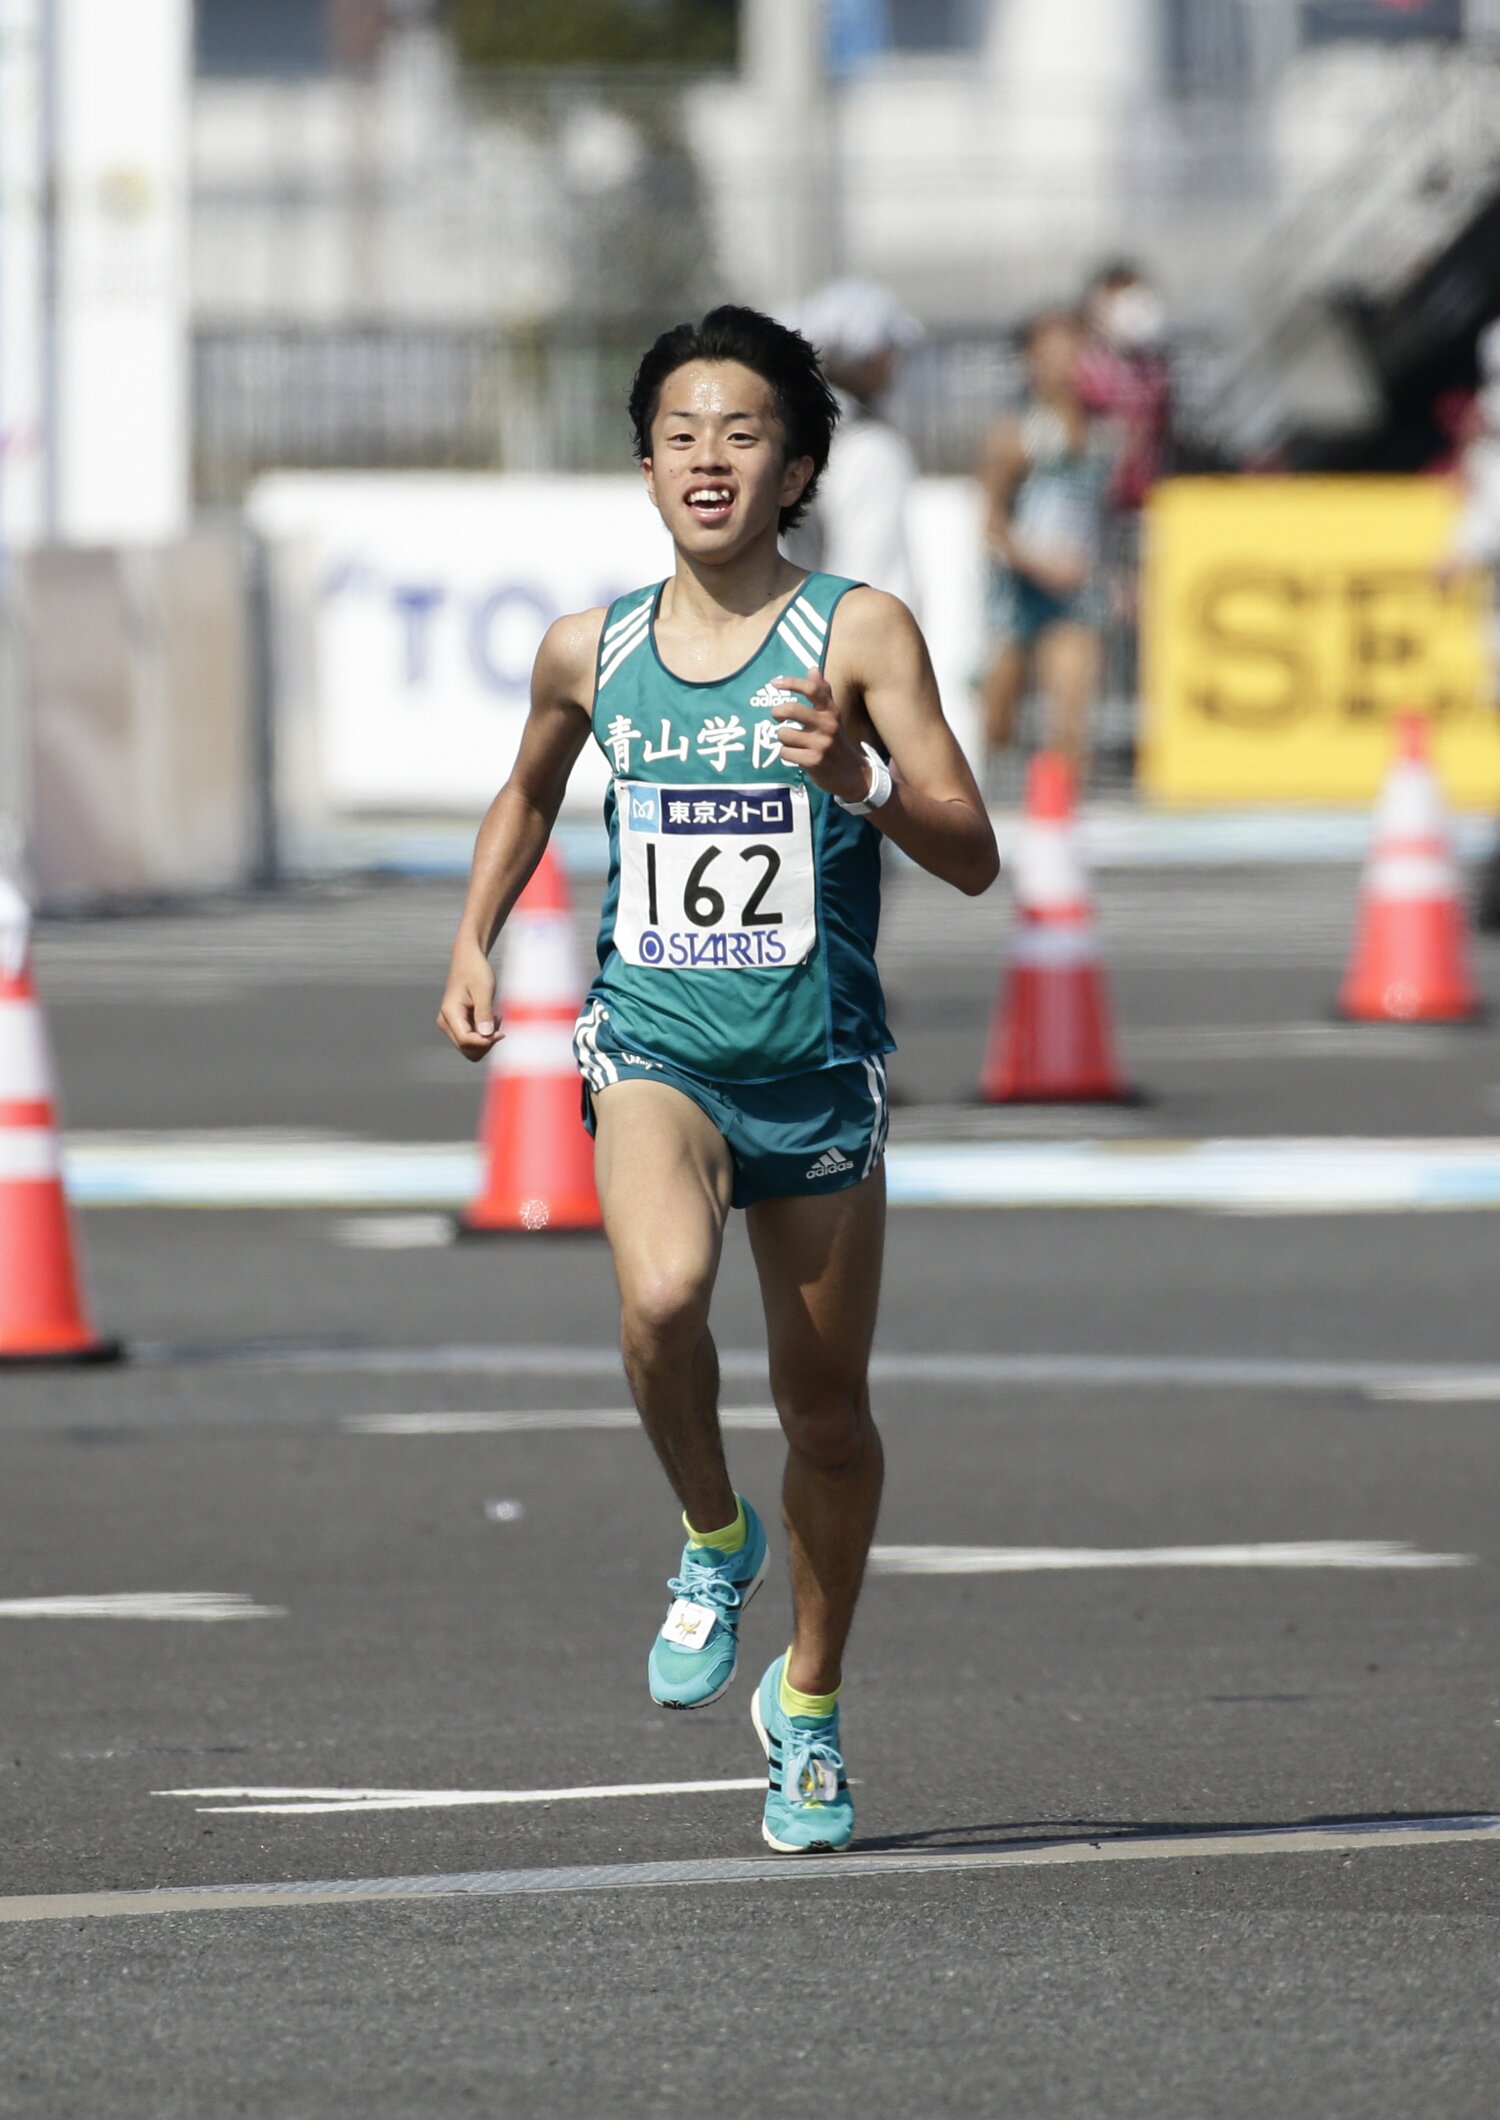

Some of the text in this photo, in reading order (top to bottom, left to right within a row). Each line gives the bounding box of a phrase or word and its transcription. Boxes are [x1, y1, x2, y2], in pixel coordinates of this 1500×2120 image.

[668, 801, 784, 824] 東京メトロ
[646, 843, 784, 928] 162
[806, 1160, 854, 1179] adidas
